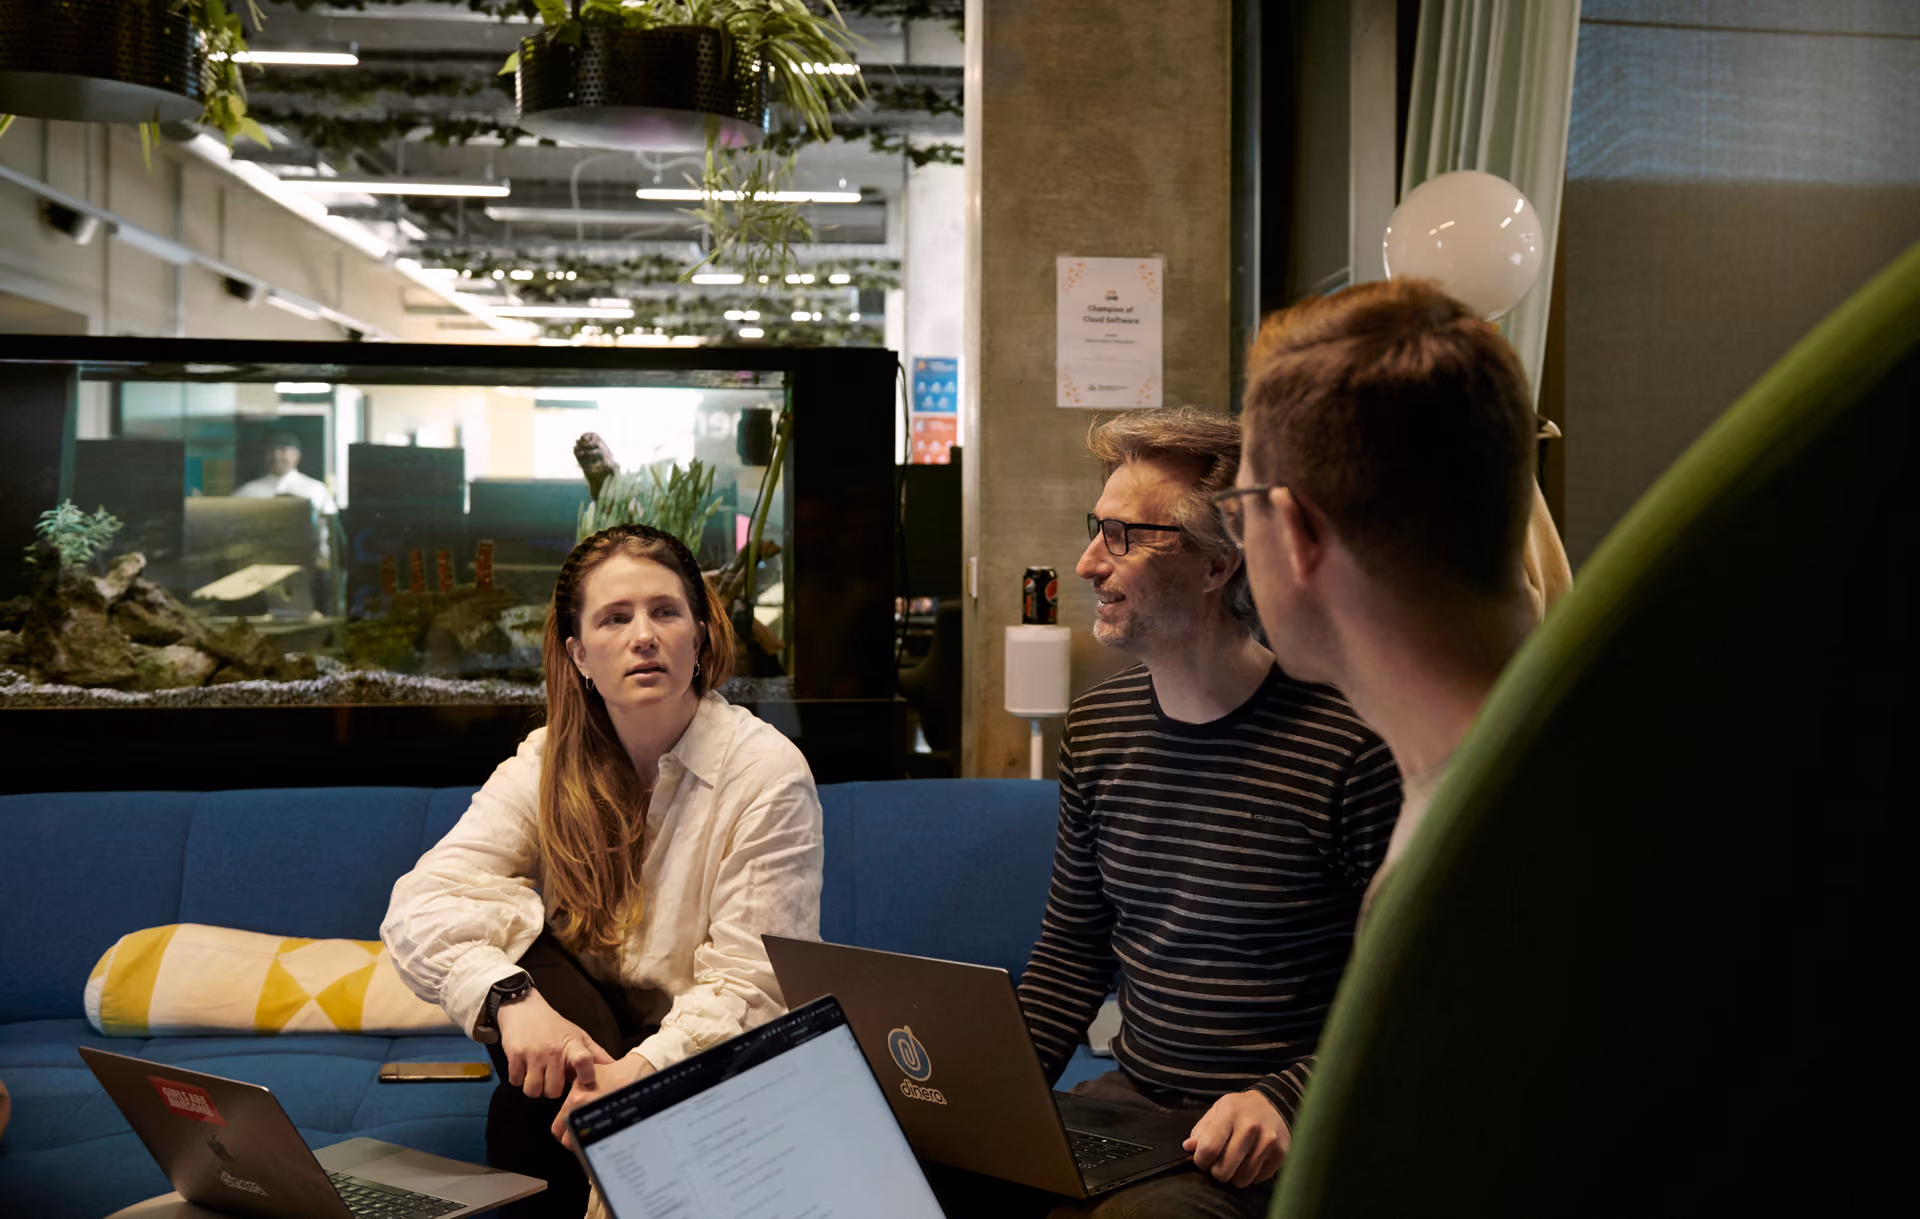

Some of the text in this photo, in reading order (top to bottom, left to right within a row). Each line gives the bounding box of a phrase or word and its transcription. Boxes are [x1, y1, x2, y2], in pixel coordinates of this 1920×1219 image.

[1087, 304, 1134, 313] Champion of
[1083, 315, 1139, 324] Cloud Software
[162, 1086, 206, 1104] GIRLS ARE
